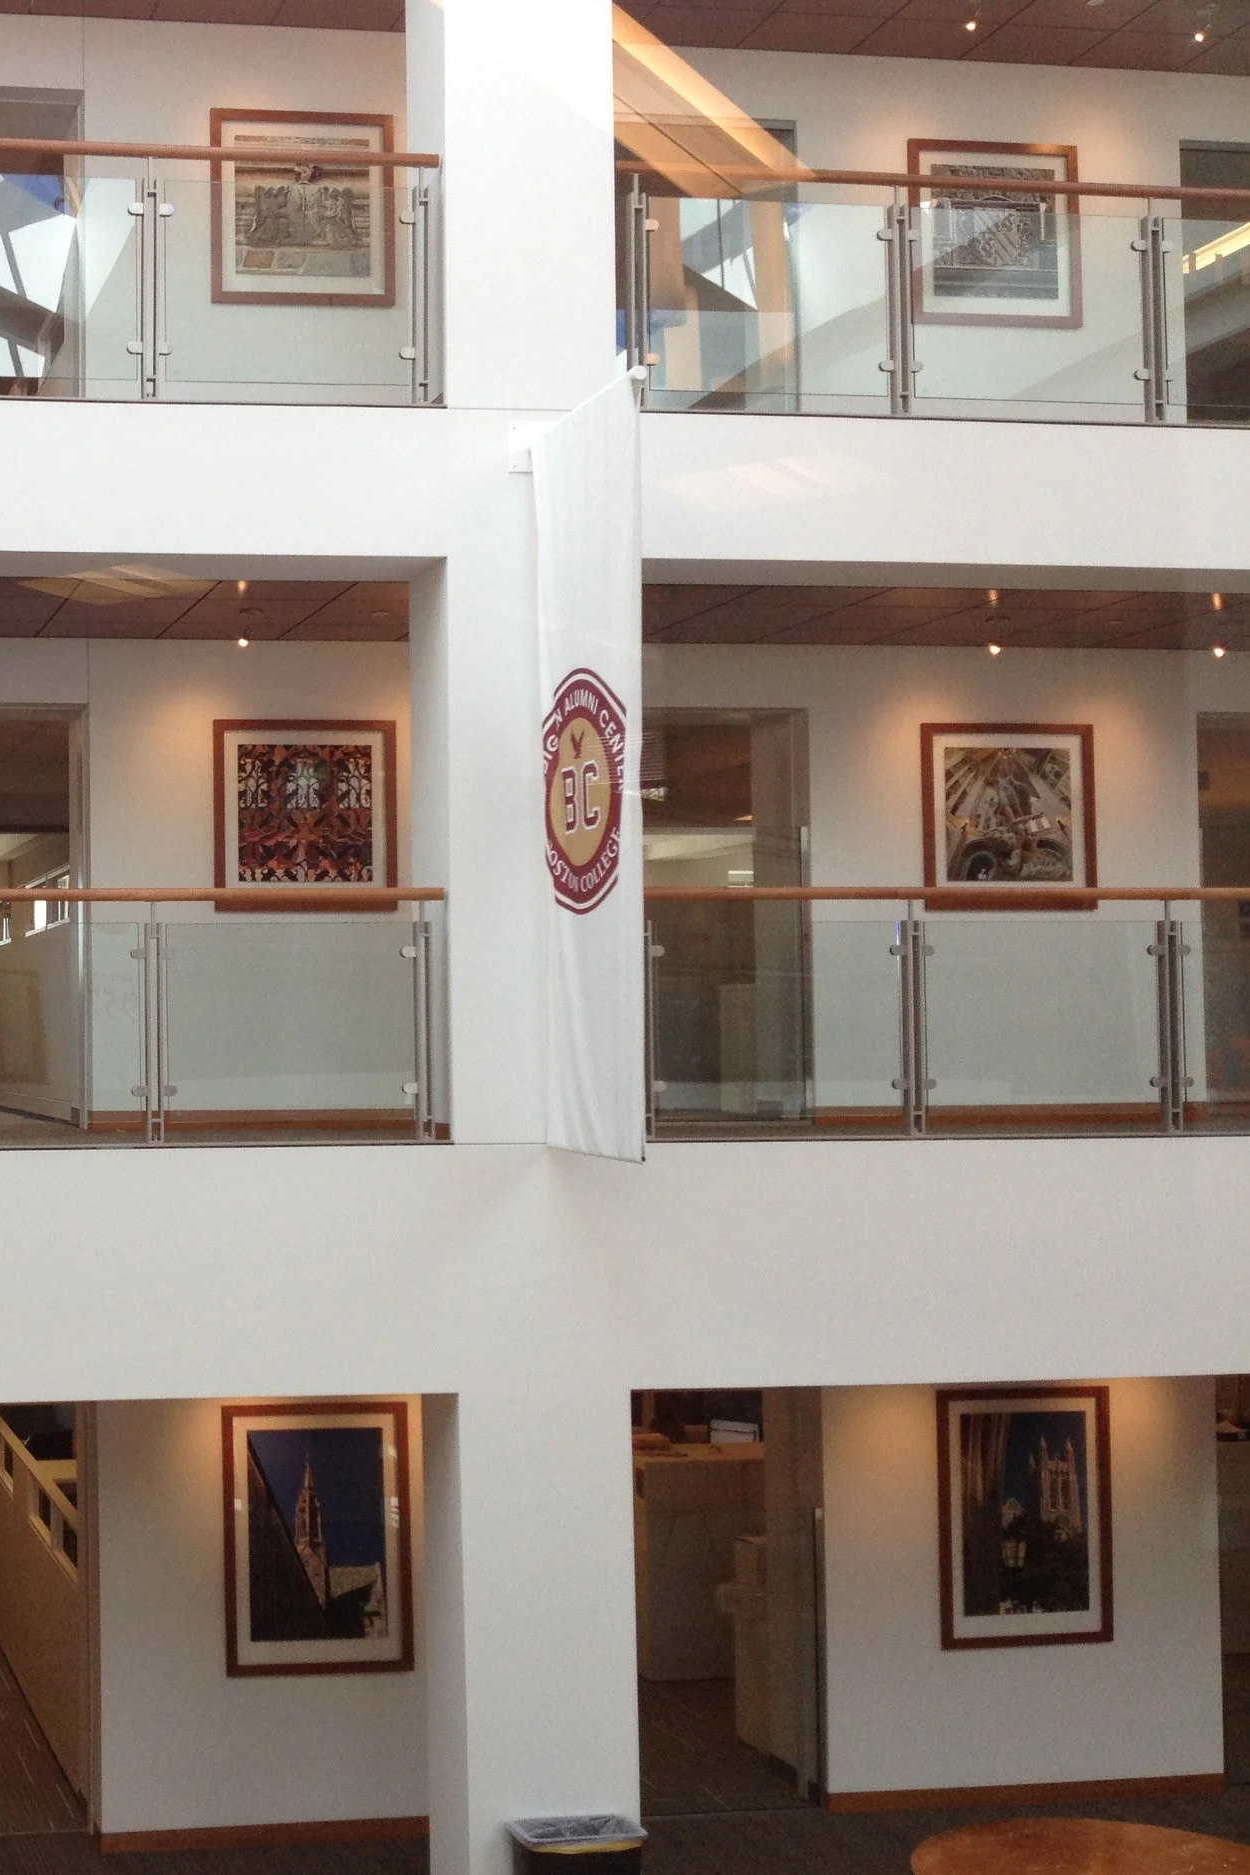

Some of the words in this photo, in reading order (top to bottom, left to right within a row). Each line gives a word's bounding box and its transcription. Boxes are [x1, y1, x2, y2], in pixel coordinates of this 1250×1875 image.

[564, 688, 598, 715] ALUMNI
[561, 760, 601, 835] BC
[548, 842, 579, 892] OSTON
